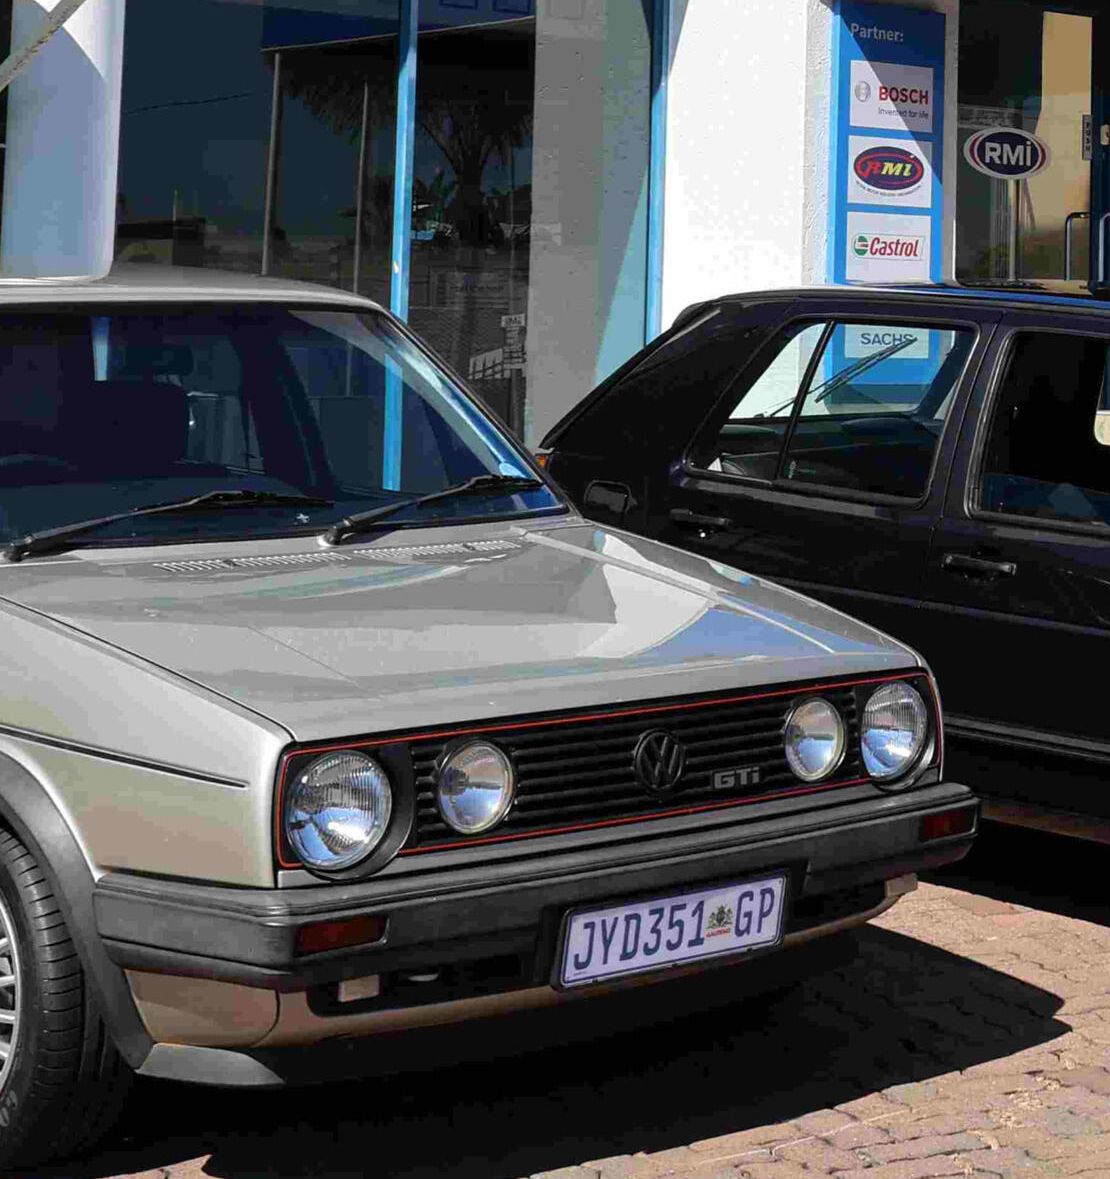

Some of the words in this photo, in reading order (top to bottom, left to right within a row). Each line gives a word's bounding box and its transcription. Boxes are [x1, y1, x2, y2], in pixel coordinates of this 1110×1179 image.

[850, 23, 904, 42] Partner:
[878, 85, 929, 105] BOSCH
[869, 237, 919, 257] Castrol
[573, 899, 705, 970] JYD351
[734, 887, 775, 937] GP
